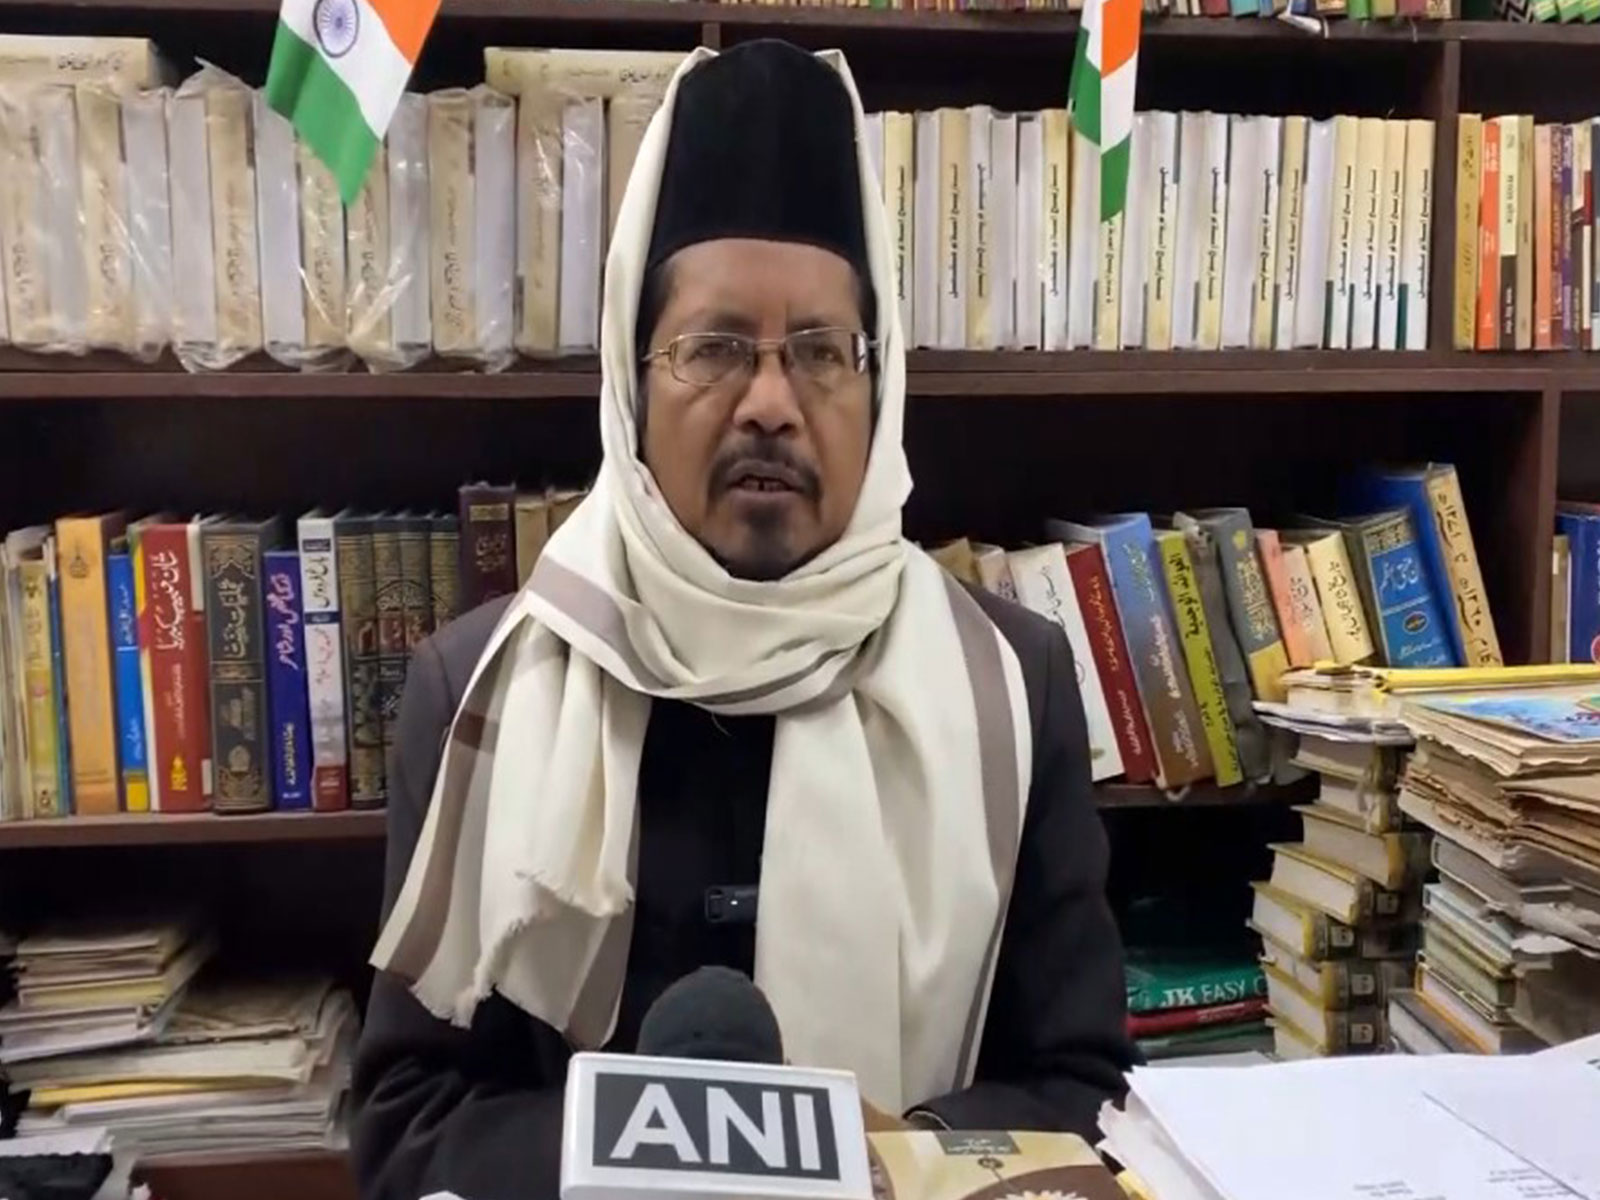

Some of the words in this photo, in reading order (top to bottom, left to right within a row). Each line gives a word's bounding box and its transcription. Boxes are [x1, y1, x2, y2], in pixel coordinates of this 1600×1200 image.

[1159, 985, 1197, 1007] JK
[1201, 979, 1246, 1003] EASY
[609, 1081, 821, 1172] ANI
